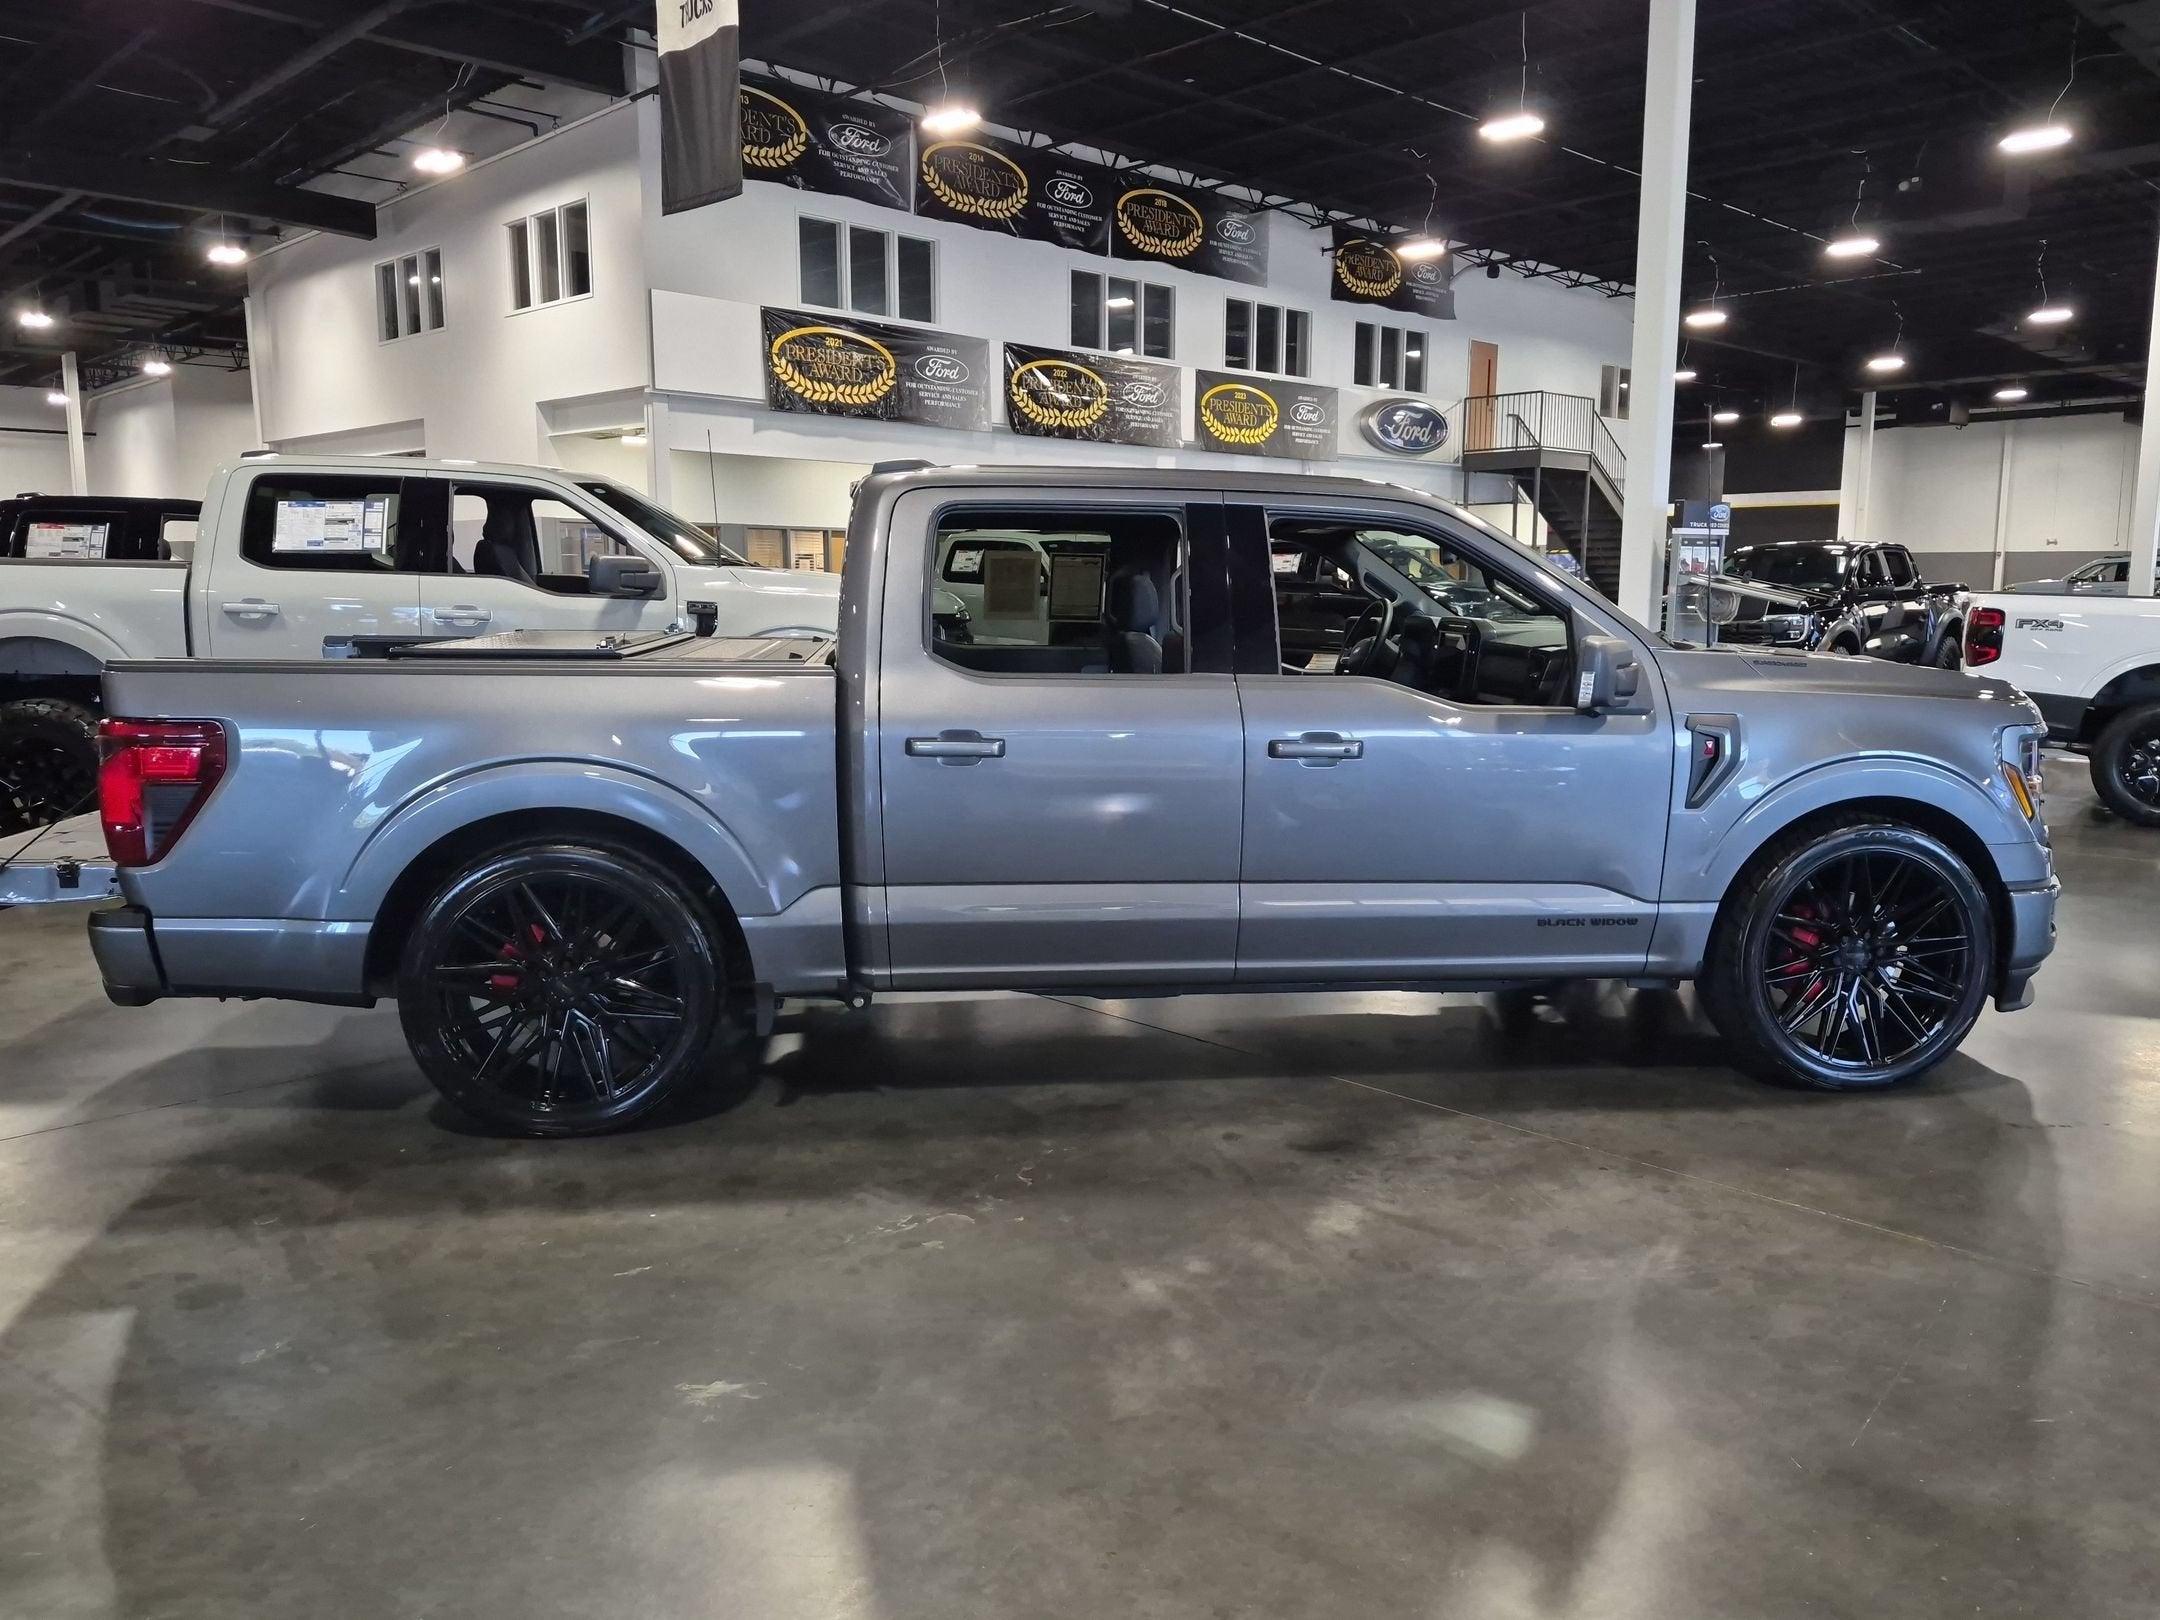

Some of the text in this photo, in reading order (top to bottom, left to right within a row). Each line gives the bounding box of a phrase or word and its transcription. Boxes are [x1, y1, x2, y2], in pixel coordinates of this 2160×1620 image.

[841, 127, 881, 152] Ford
[968, 151, 984, 163] 2014
[934, 154, 1020, 190] PRESIDENT'S
[953, 174, 1000, 198] AWARD
[1054, 181, 1085, 204] Ford
[1126, 202, 1196, 230] PRESIDENT'S
[1142, 218, 1180, 238] AWARD
[1224, 221, 1249, 240] Ford
[1355, 266, 1384, 281] AWARD
[1416, 264, 1438, 281] Ford
[825, 337, 843, 347] 2021
[785, 343, 886, 370] PRESIDENT'S
[808, 363, 863, 383] AWARD
[925, 358, 959, 379] Ford
[1053, 369, 1068, 377] 2022
[1131, 384, 1158, 403] Ford
[1210, 398, 1272, 417] PRESIDENT'S
[1296, 405, 1319, 422] Ford
[1223, 412, 1257, 427] AWARD
[1390, 410, 1432, 442] Ford
[2015, 618, 2064, 628] FX4
[1537, 918, 1638, 927] BLACK WIDOW
